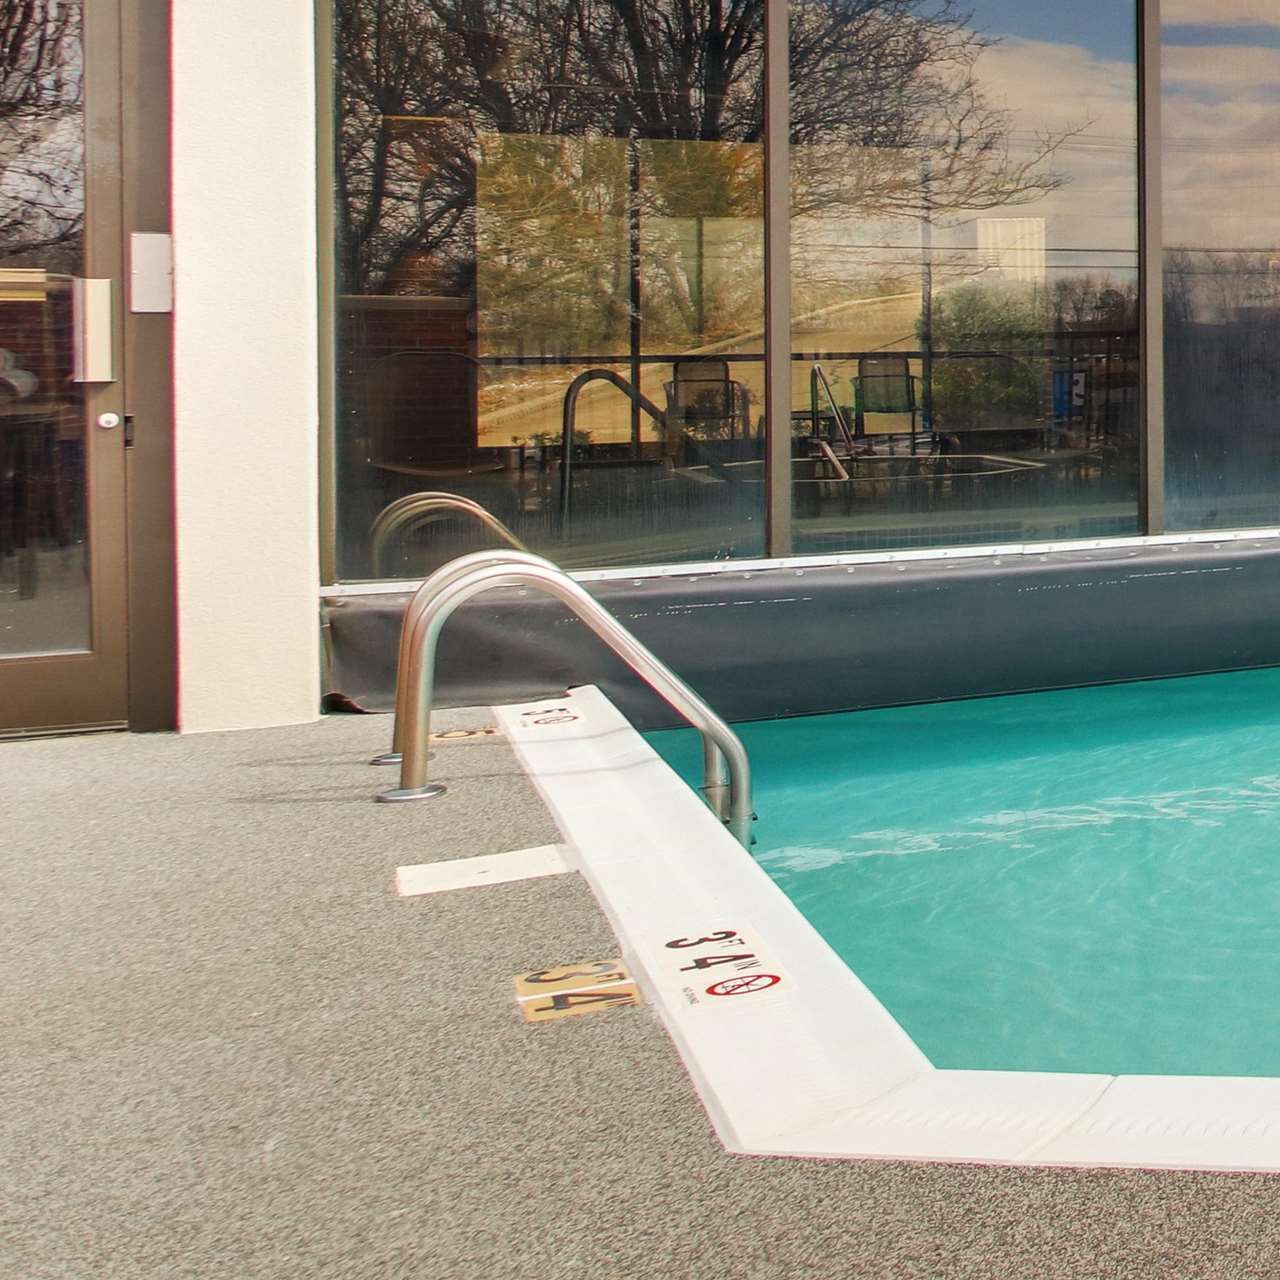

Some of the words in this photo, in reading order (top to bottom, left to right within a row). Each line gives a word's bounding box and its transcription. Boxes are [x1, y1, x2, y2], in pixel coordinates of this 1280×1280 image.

[665, 931, 737, 949] 3
[680, 953, 755, 971] 4
[524, 962, 618, 983] 3
[534, 992, 632, 1011] 4
